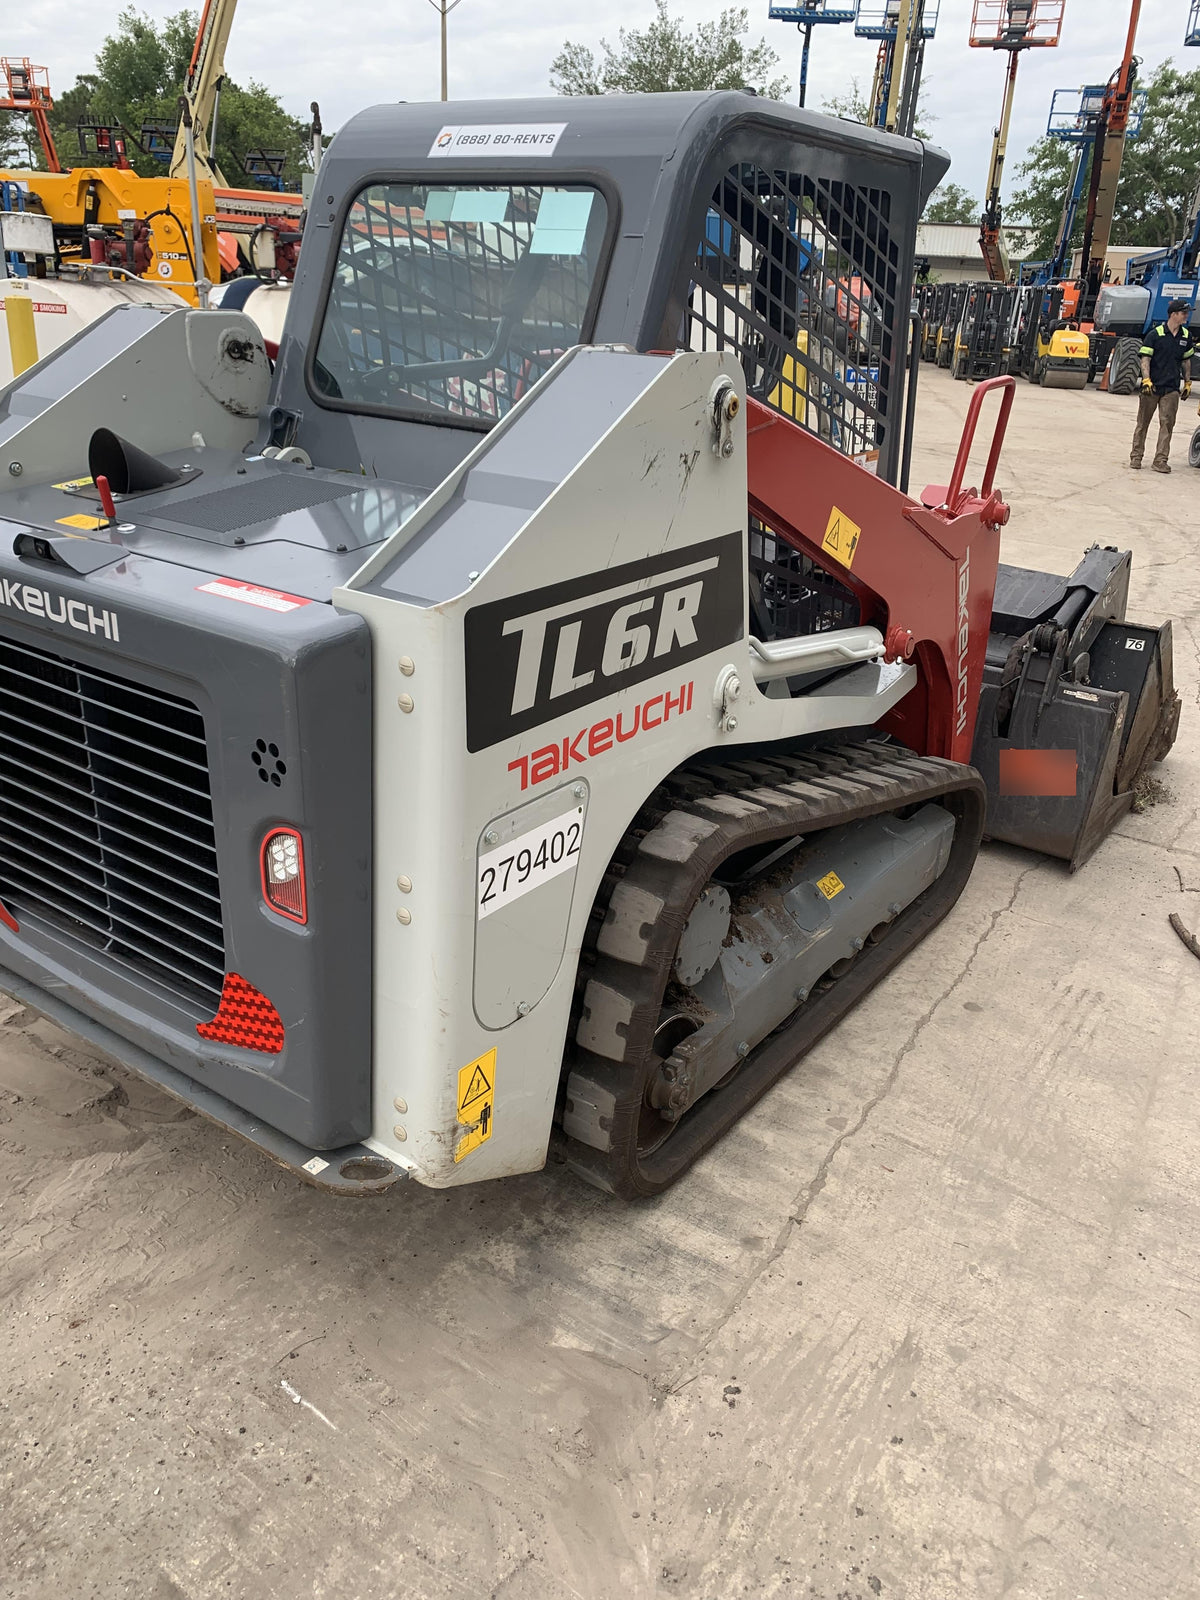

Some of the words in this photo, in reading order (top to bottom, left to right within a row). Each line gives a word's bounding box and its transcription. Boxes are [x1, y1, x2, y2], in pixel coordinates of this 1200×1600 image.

[456, 134, 491, 145] (888)
[493, 133, 556, 145] 80-RENTS
[40, 304, 65, 313] SMOKING
[502, 555, 719, 716] TL6R
[1127, 640, 1143, 650] 76
[480, 822, 580, 904] 279402
